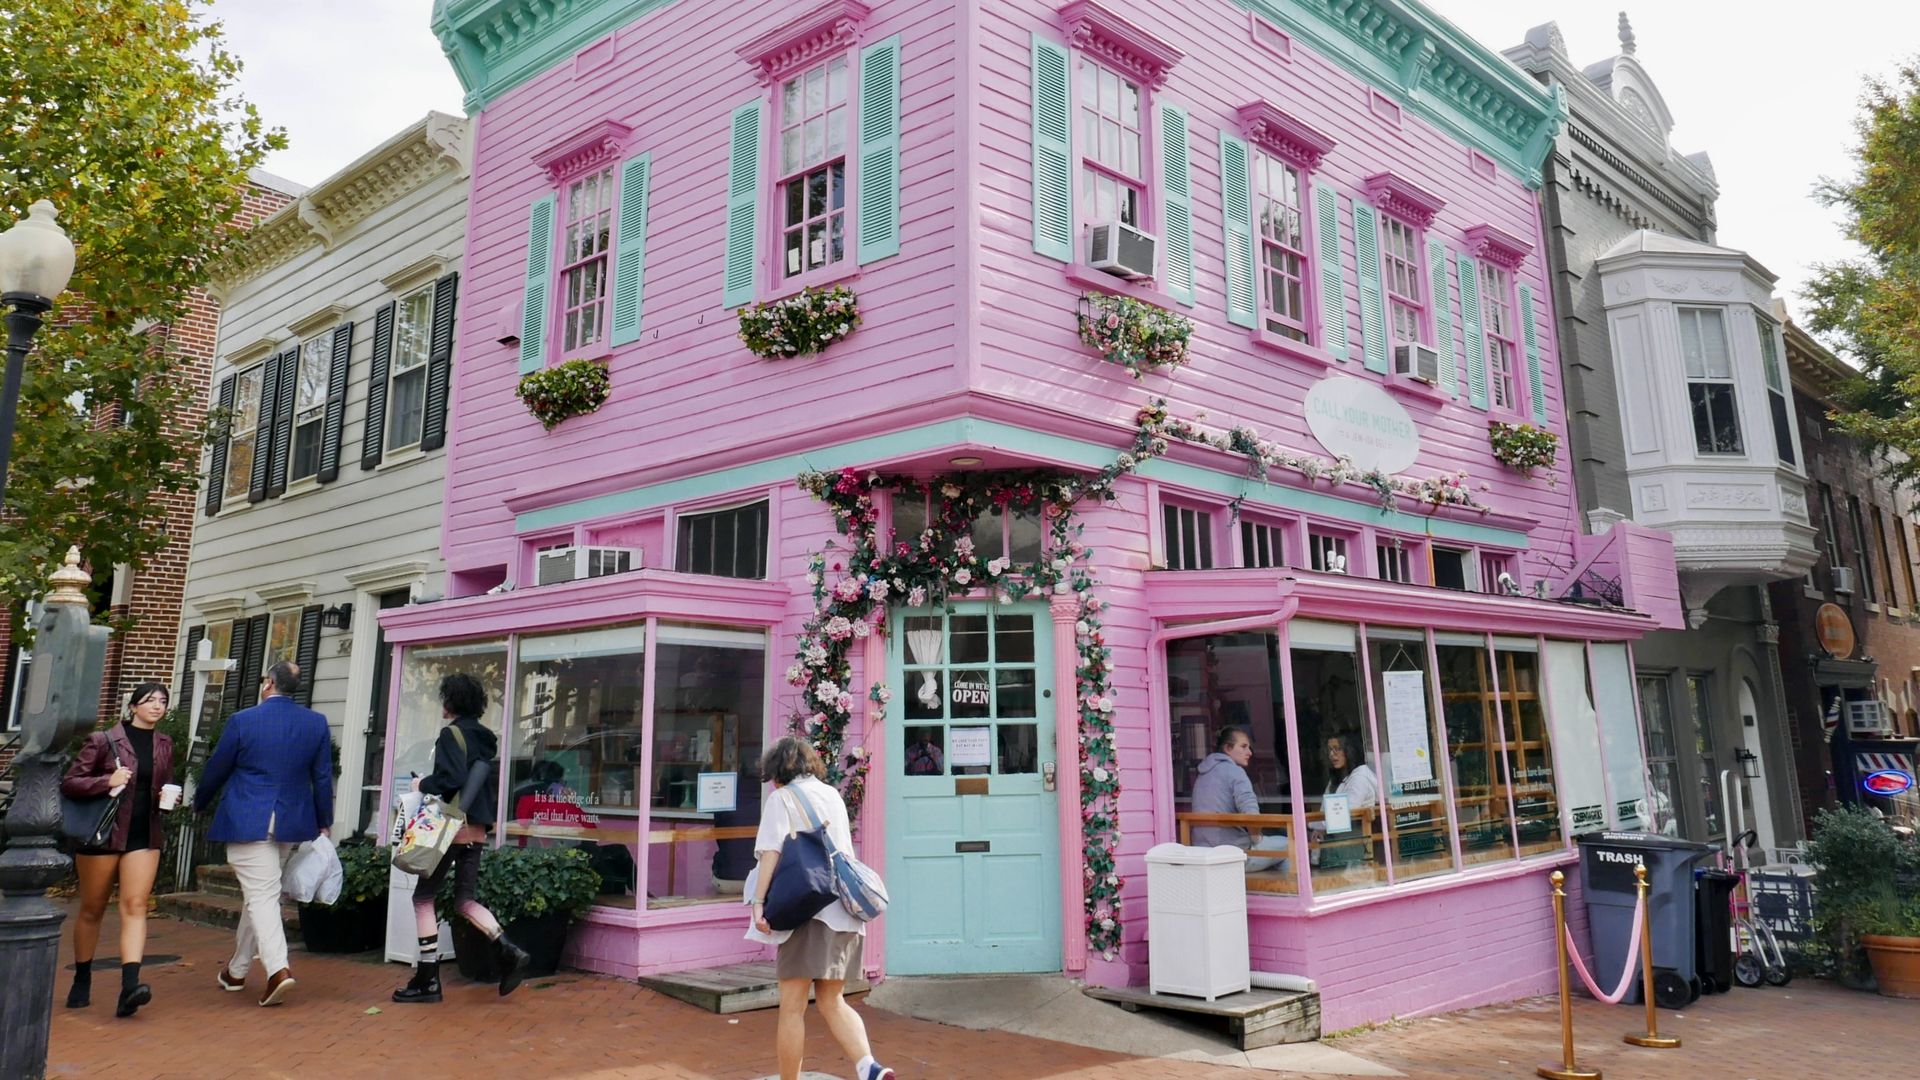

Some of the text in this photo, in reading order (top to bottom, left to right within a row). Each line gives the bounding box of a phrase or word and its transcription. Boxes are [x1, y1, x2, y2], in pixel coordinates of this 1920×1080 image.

[1313, 397, 1412, 440] CALL YOUR MOTHER
[953, 689, 988, 704] OPEN
[1404, 781, 1415, 791] and
[1420, 779, 1430, 789] red
[534, 790, 600, 808] It is at the edge of a
[533, 808, 549, 824] petal
[550, 808, 564, 821] that
[565, 809, 580, 823] love
[1596, 850, 1643, 865] TRASH
